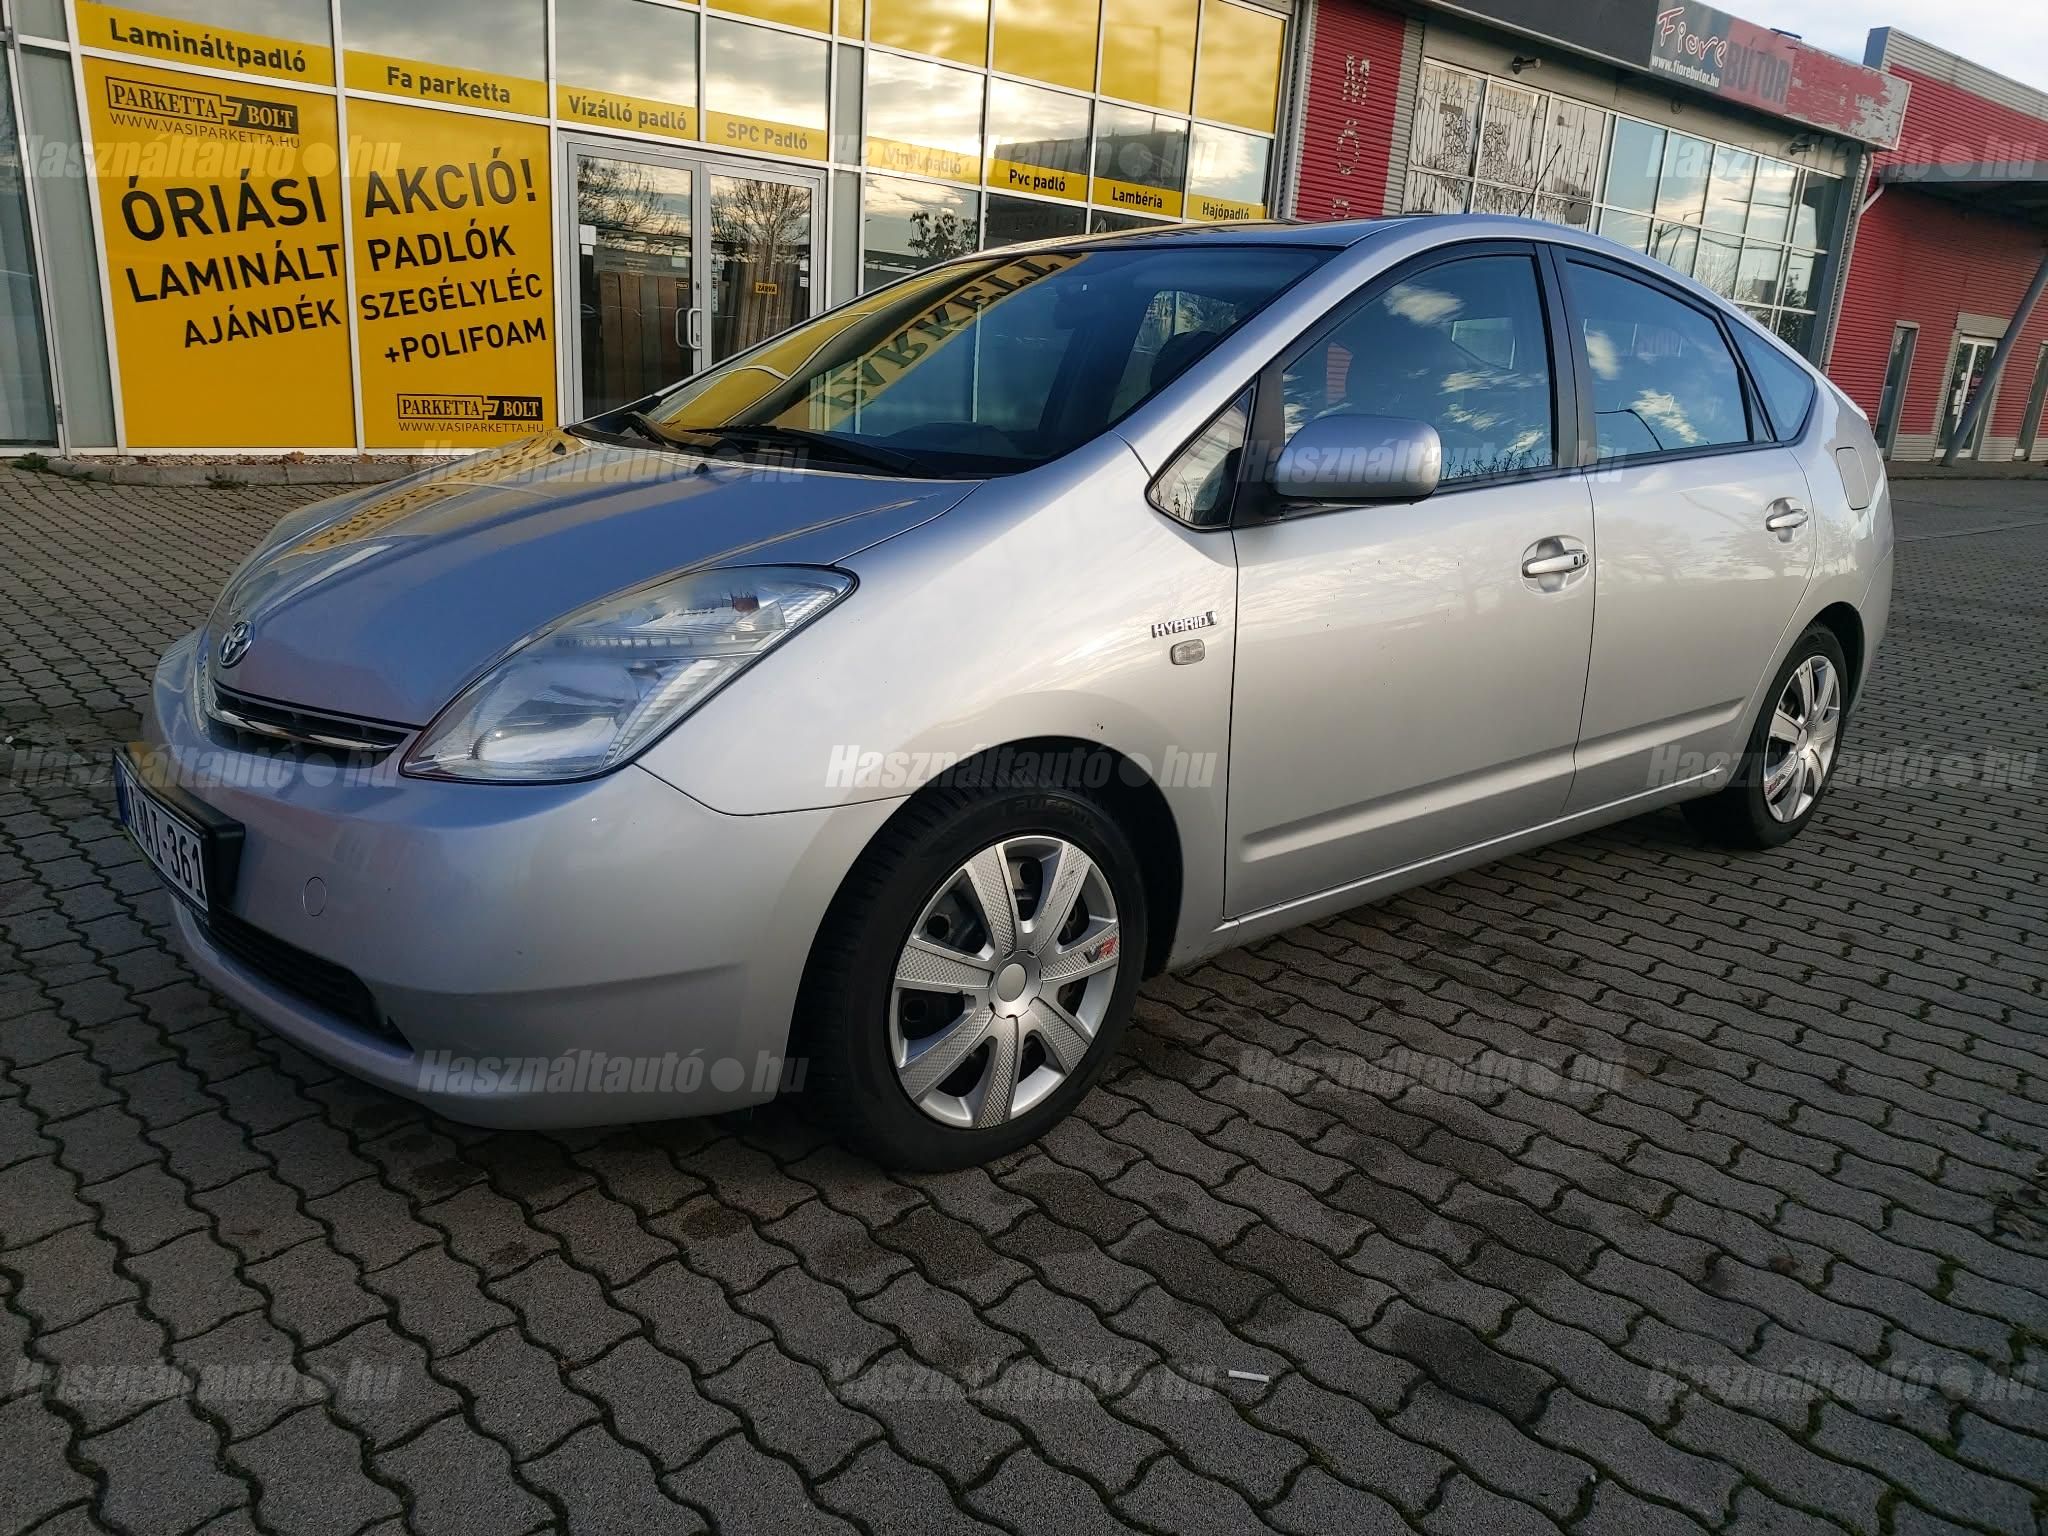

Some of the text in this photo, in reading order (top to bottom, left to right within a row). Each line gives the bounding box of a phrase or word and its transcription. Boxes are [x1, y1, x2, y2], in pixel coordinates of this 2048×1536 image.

[109, 18, 306, 73] Lamináltpadló
[1657, 6, 1728, 68] Fiore
[387, 66, 510, 104] Fa parketta
[112, 82, 295, 130] PARKETTA BOLT
[568, 95, 687, 132] Vízálló padló
[110, 112, 300, 148] WWW.VASIPARKETTA.HU
[726, 121, 808, 150] SPC Padló
[886, 147, 962, 175] Vinyl padló
[121, 147, 537, 242] ÓRIÁSI AKCIÓ!
[1009, 168, 1066, 192] Pvc padló
[1112, 187, 1163, 209] Lambéria
[1202, 202, 1250, 220] Hajópadló
[125, 218, 516, 302] LAMINÁLT PADLÓK
[184, 268, 543, 348] AJÁNDÉK SZEGÉLYLÉC
[384, 318, 547, 364] +POLIFOAM
[401, 399, 540, 418] PARKETTA BOLT
[398, 422, 544, 434] WWW.VASIPARKETTA.HU
[1151, 615, 1209, 638] HYBRID
